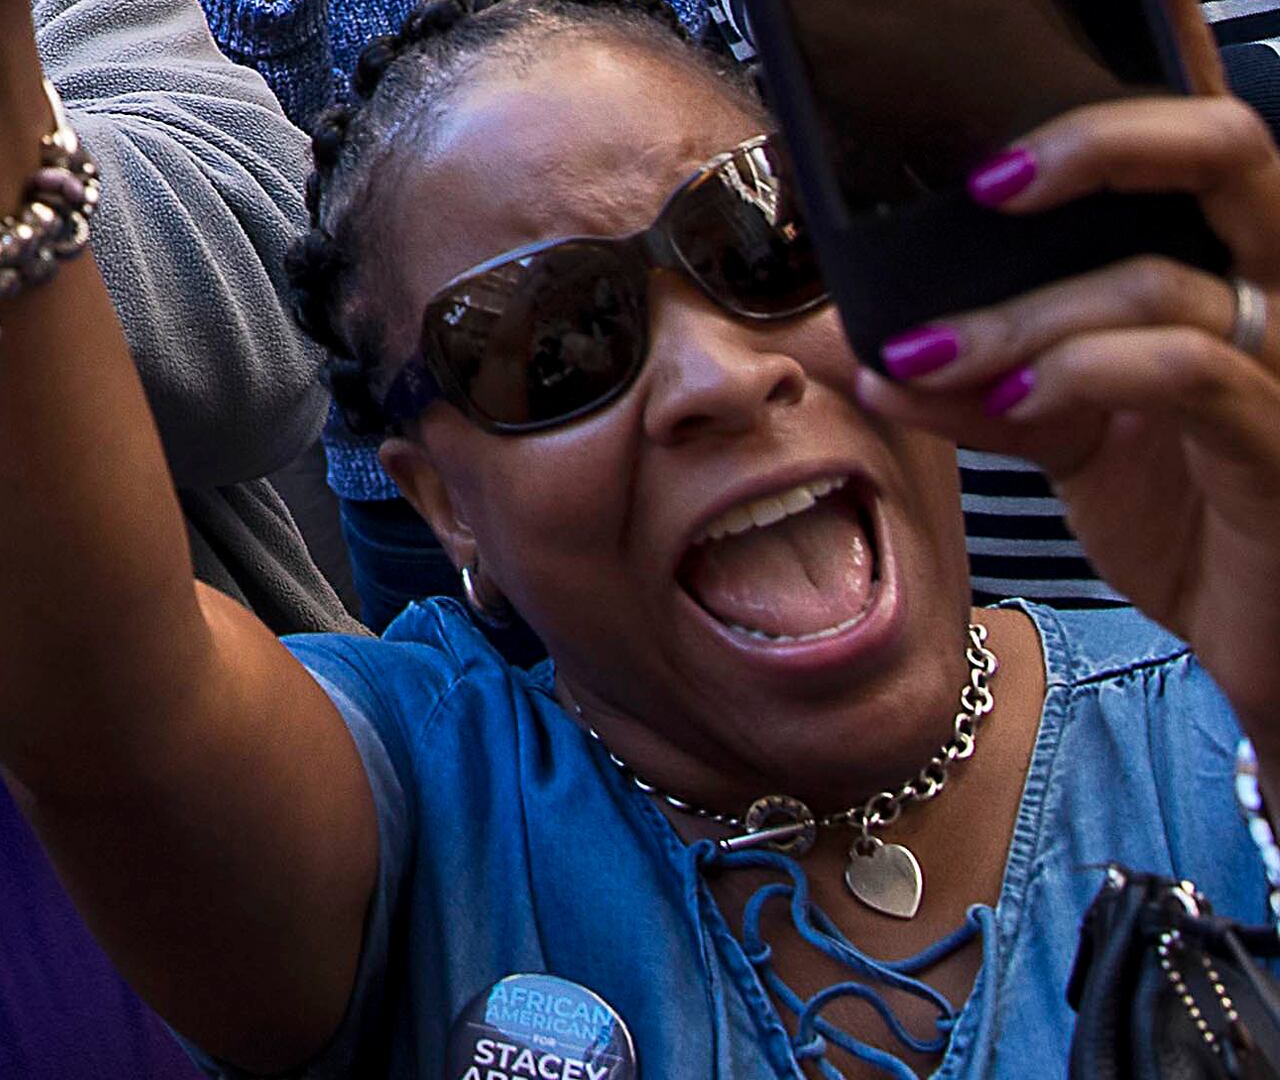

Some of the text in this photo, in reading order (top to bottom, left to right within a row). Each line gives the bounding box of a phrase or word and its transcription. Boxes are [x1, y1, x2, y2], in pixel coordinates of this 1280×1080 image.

[485, 1004, 612, 1045] AMERICANS
[490, 983, 612, 1025] AFRICAN
[474, 1038, 608, 1080] STACEY
[532, 1034, 557, 1047] FOR
